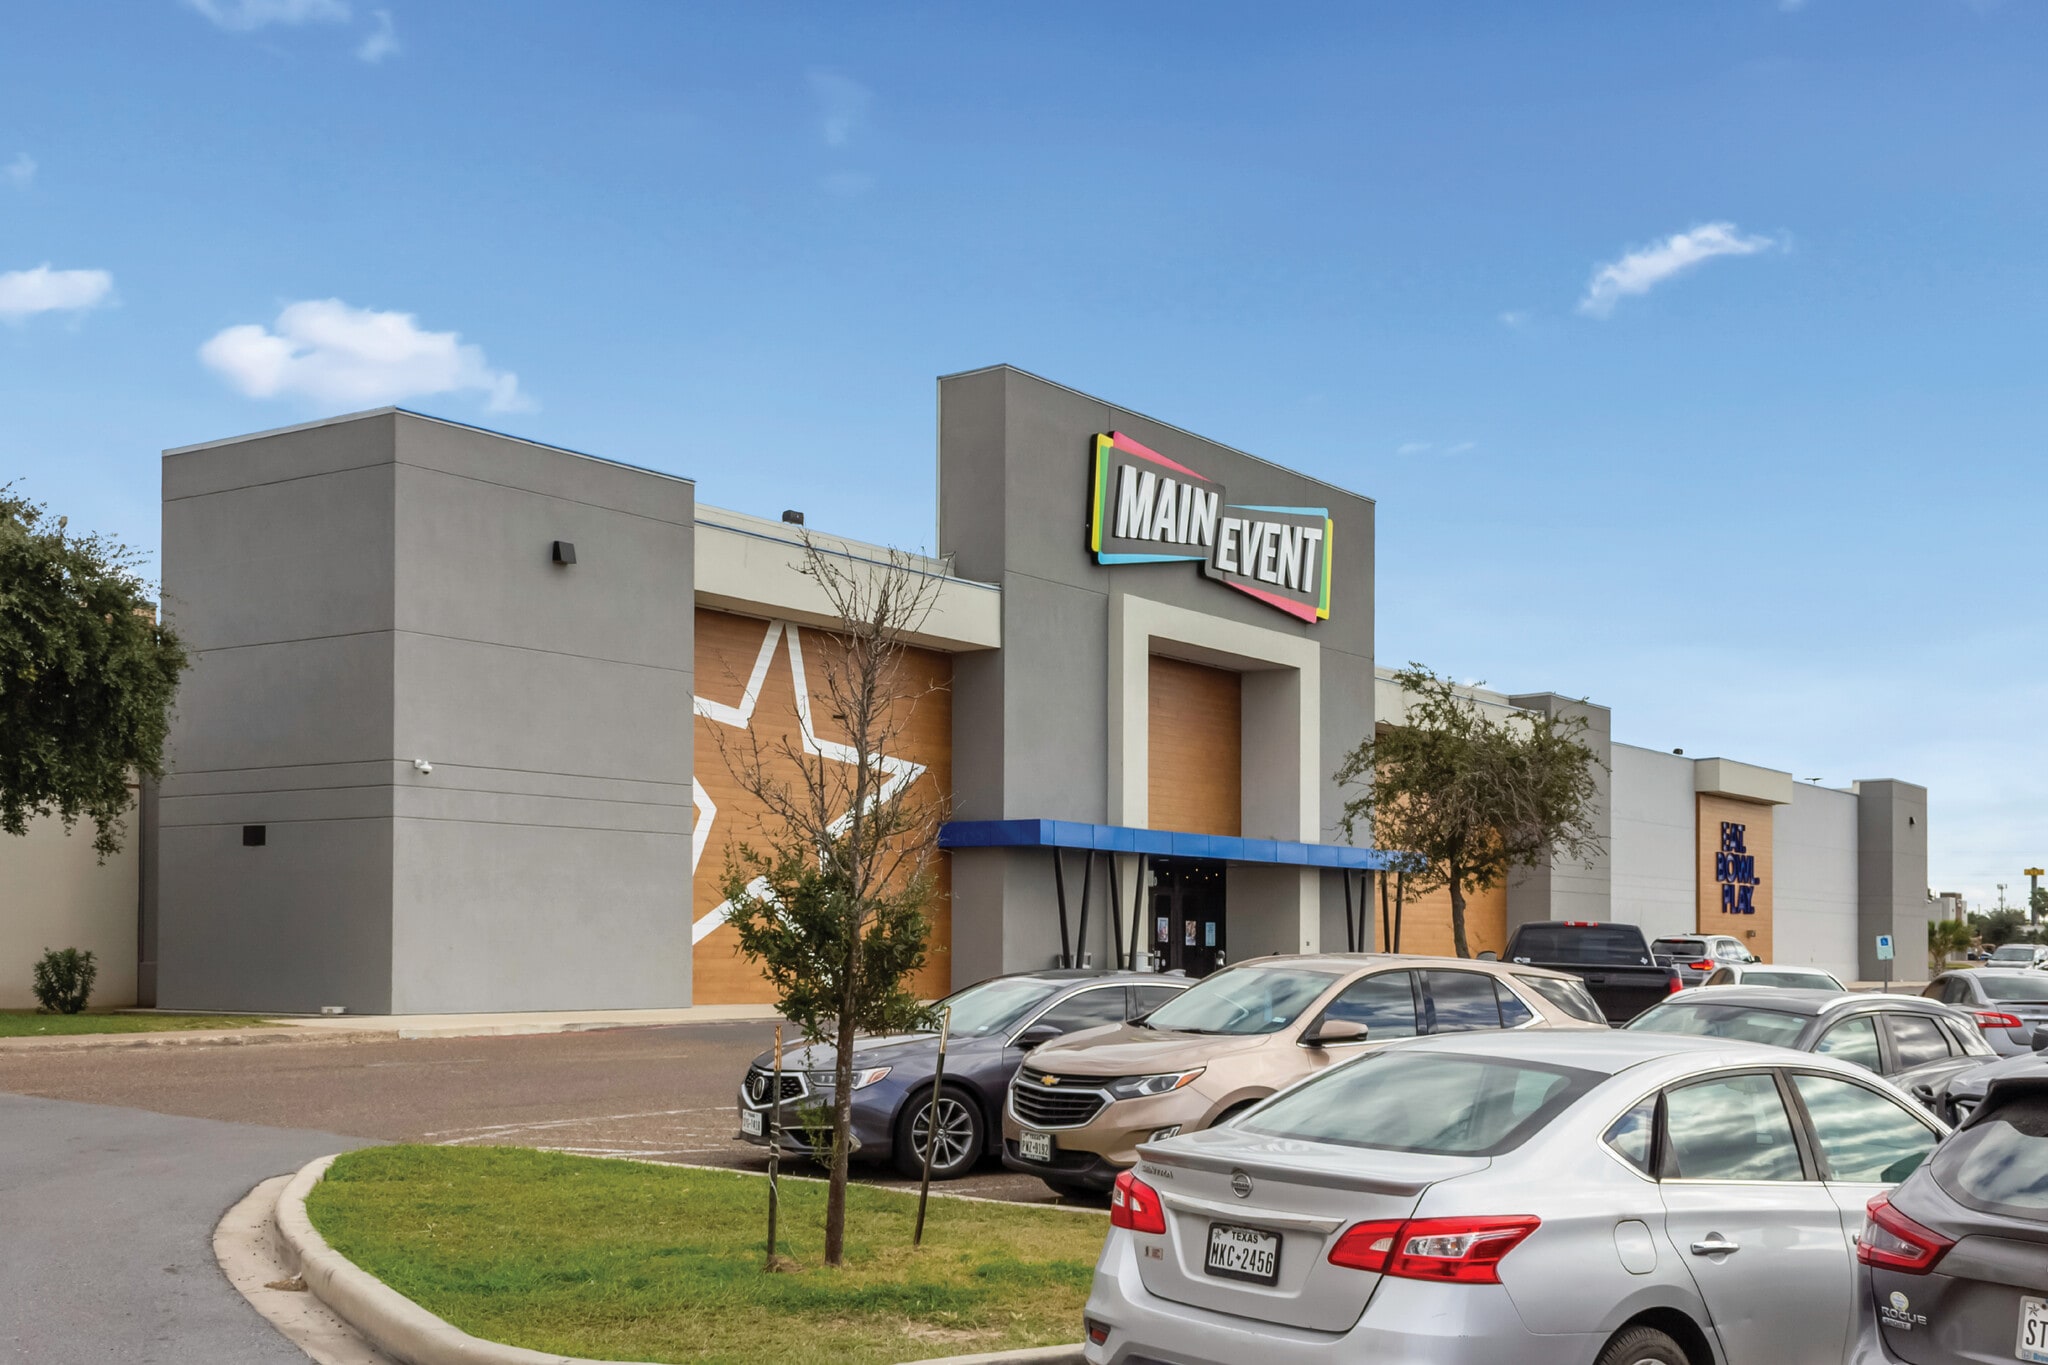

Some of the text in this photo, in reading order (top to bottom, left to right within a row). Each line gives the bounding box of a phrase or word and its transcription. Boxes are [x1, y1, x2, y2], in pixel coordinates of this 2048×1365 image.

[1115, 464, 1322, 592] MAIN EVENT
[1232, 1231, 1259, 1244] TEXAS
[1881, 1305, 1928, 1326] ROGUE
